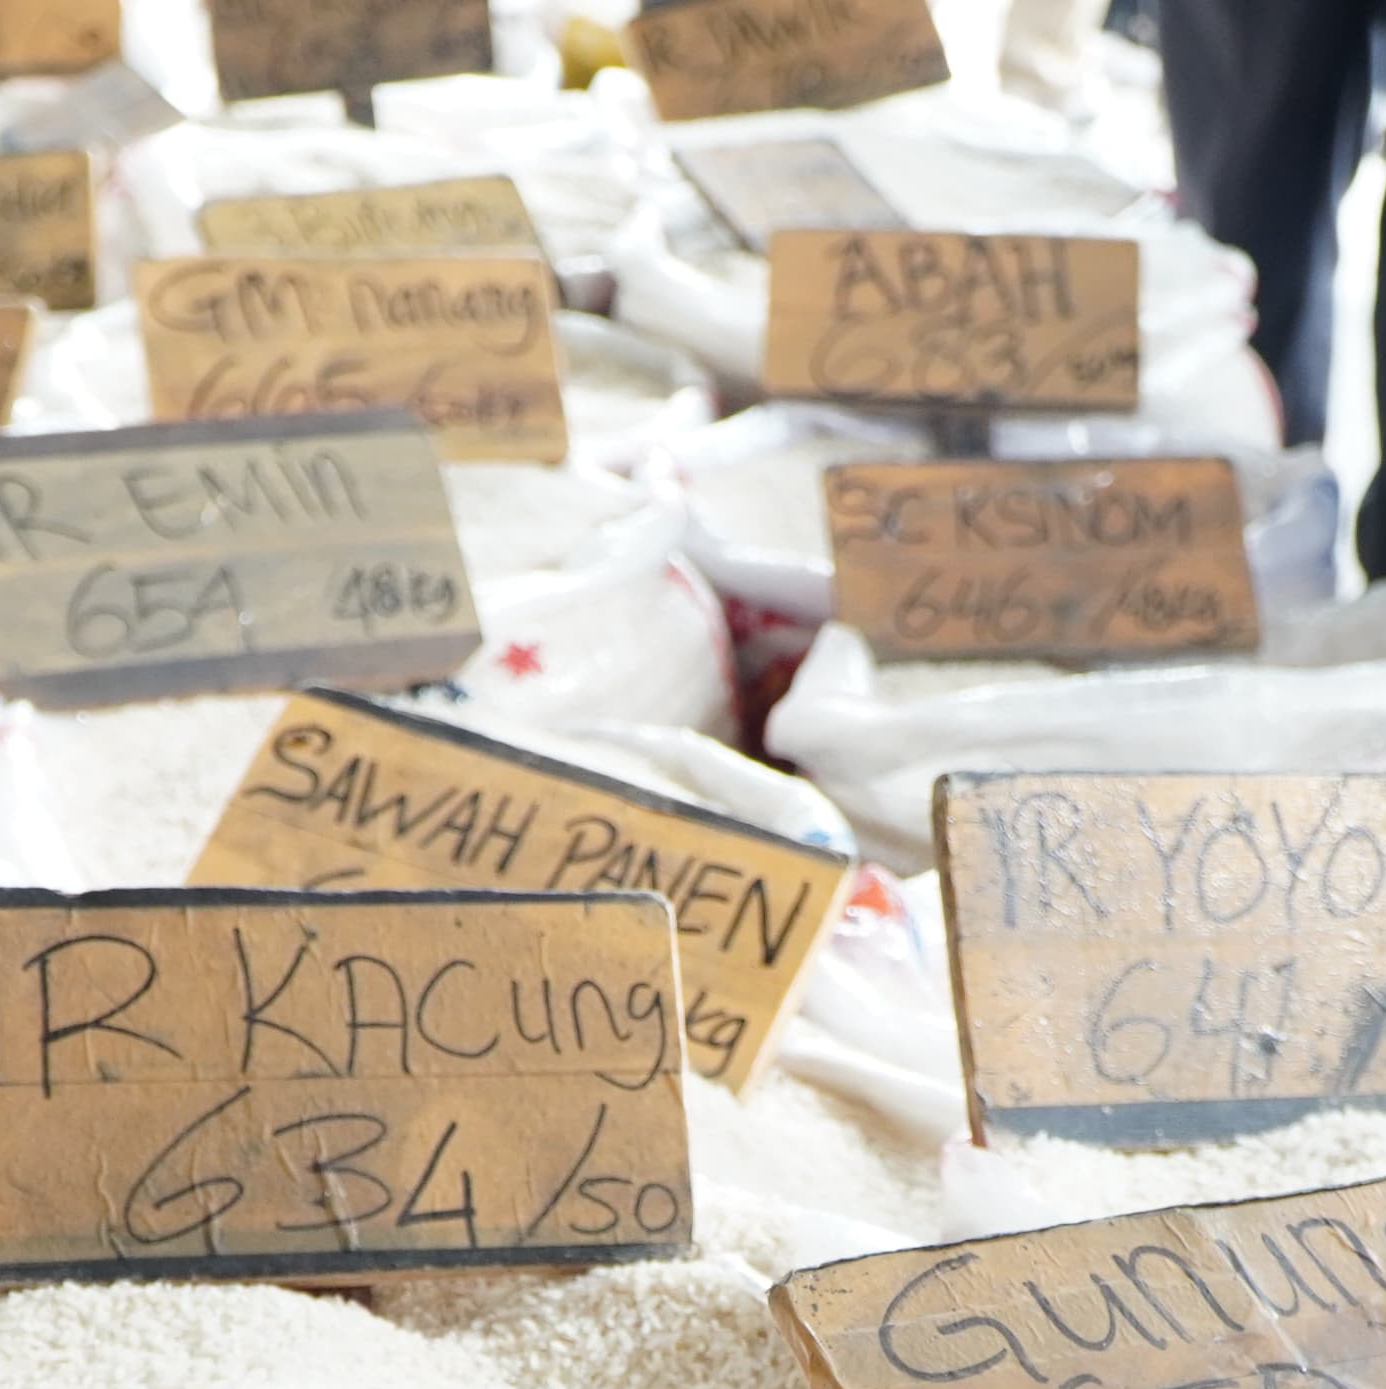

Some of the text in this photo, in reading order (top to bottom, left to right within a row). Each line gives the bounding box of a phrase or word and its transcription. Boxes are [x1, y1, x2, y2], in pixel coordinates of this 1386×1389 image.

[829, 234, 1075, 323] ABAH
[243, 724, 812, 968] SAWAH PANEN
[122, 1086, 481, 1250] 634
